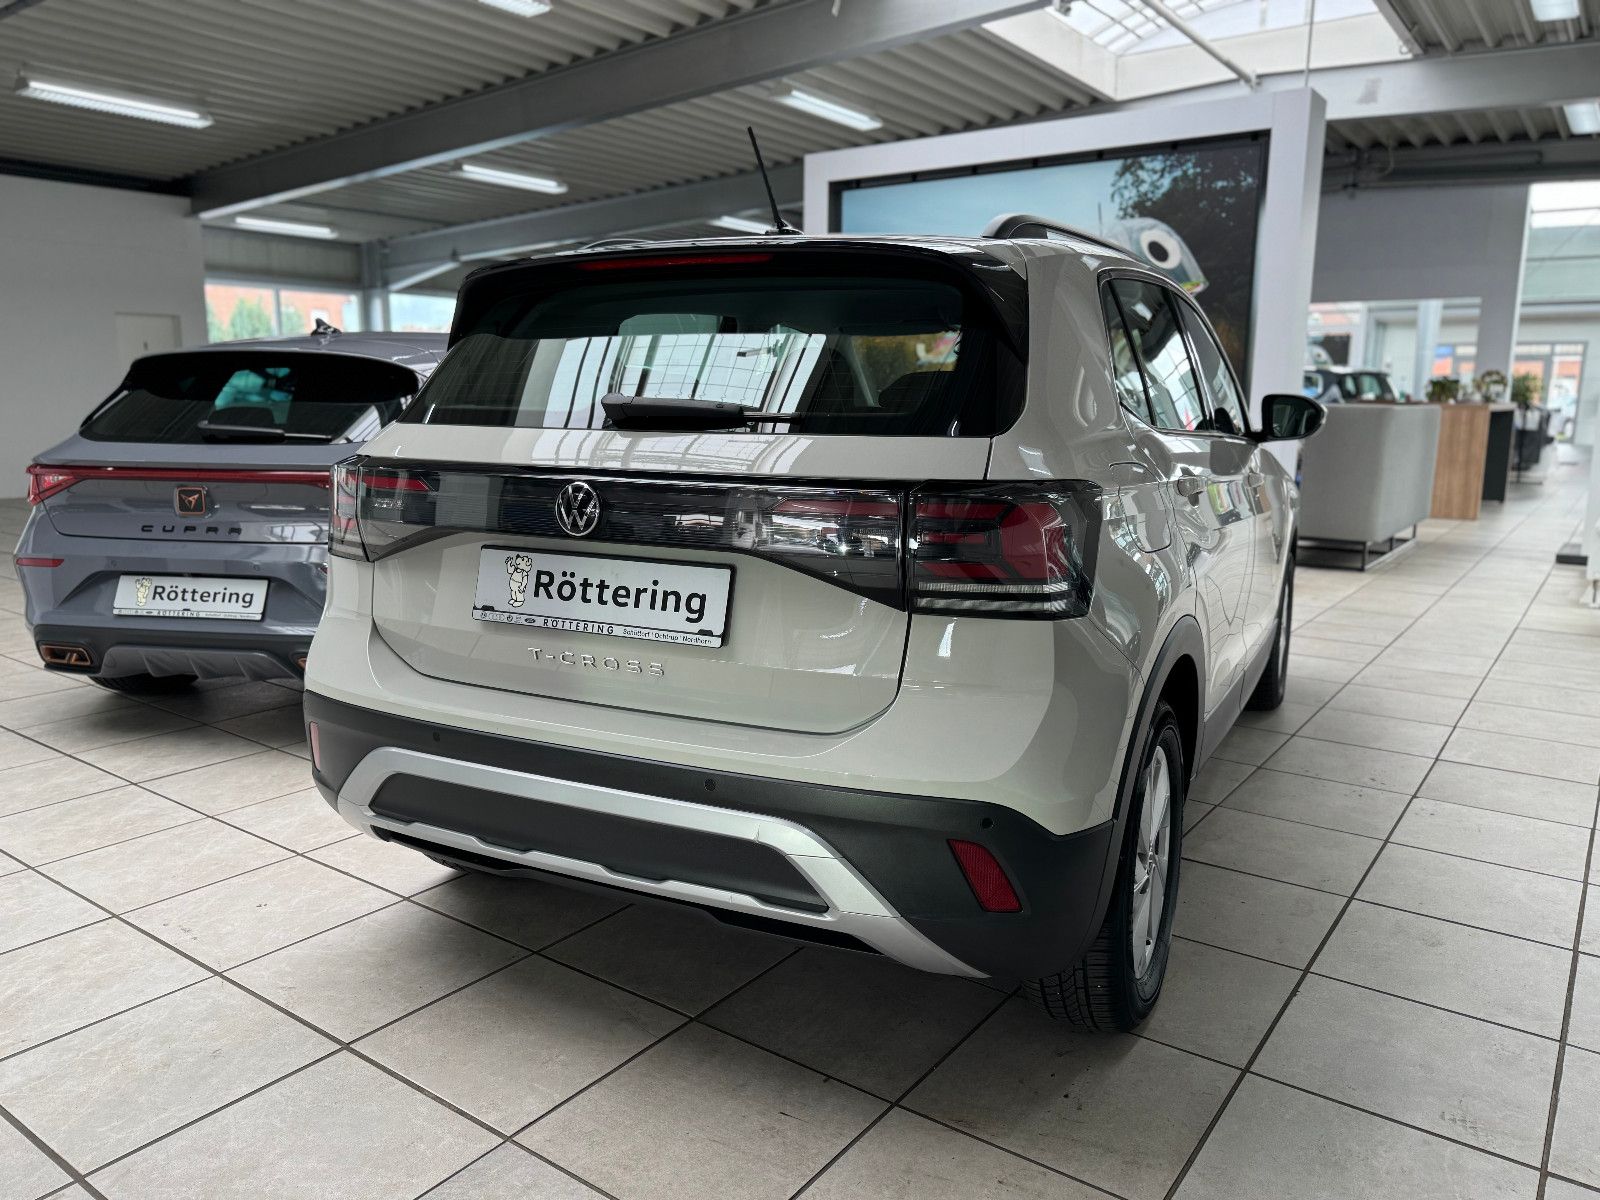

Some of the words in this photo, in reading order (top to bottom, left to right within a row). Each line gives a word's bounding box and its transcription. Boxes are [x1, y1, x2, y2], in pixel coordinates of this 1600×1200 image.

[141, 525, 242, 535] CUPRA
[152, 585, 254, 608] Röttering
[533, 569, 707, 624] Röttering
[543, 618, 614, 635] RÖTTERING
[528, 647, 665, 678] T-CROSS
